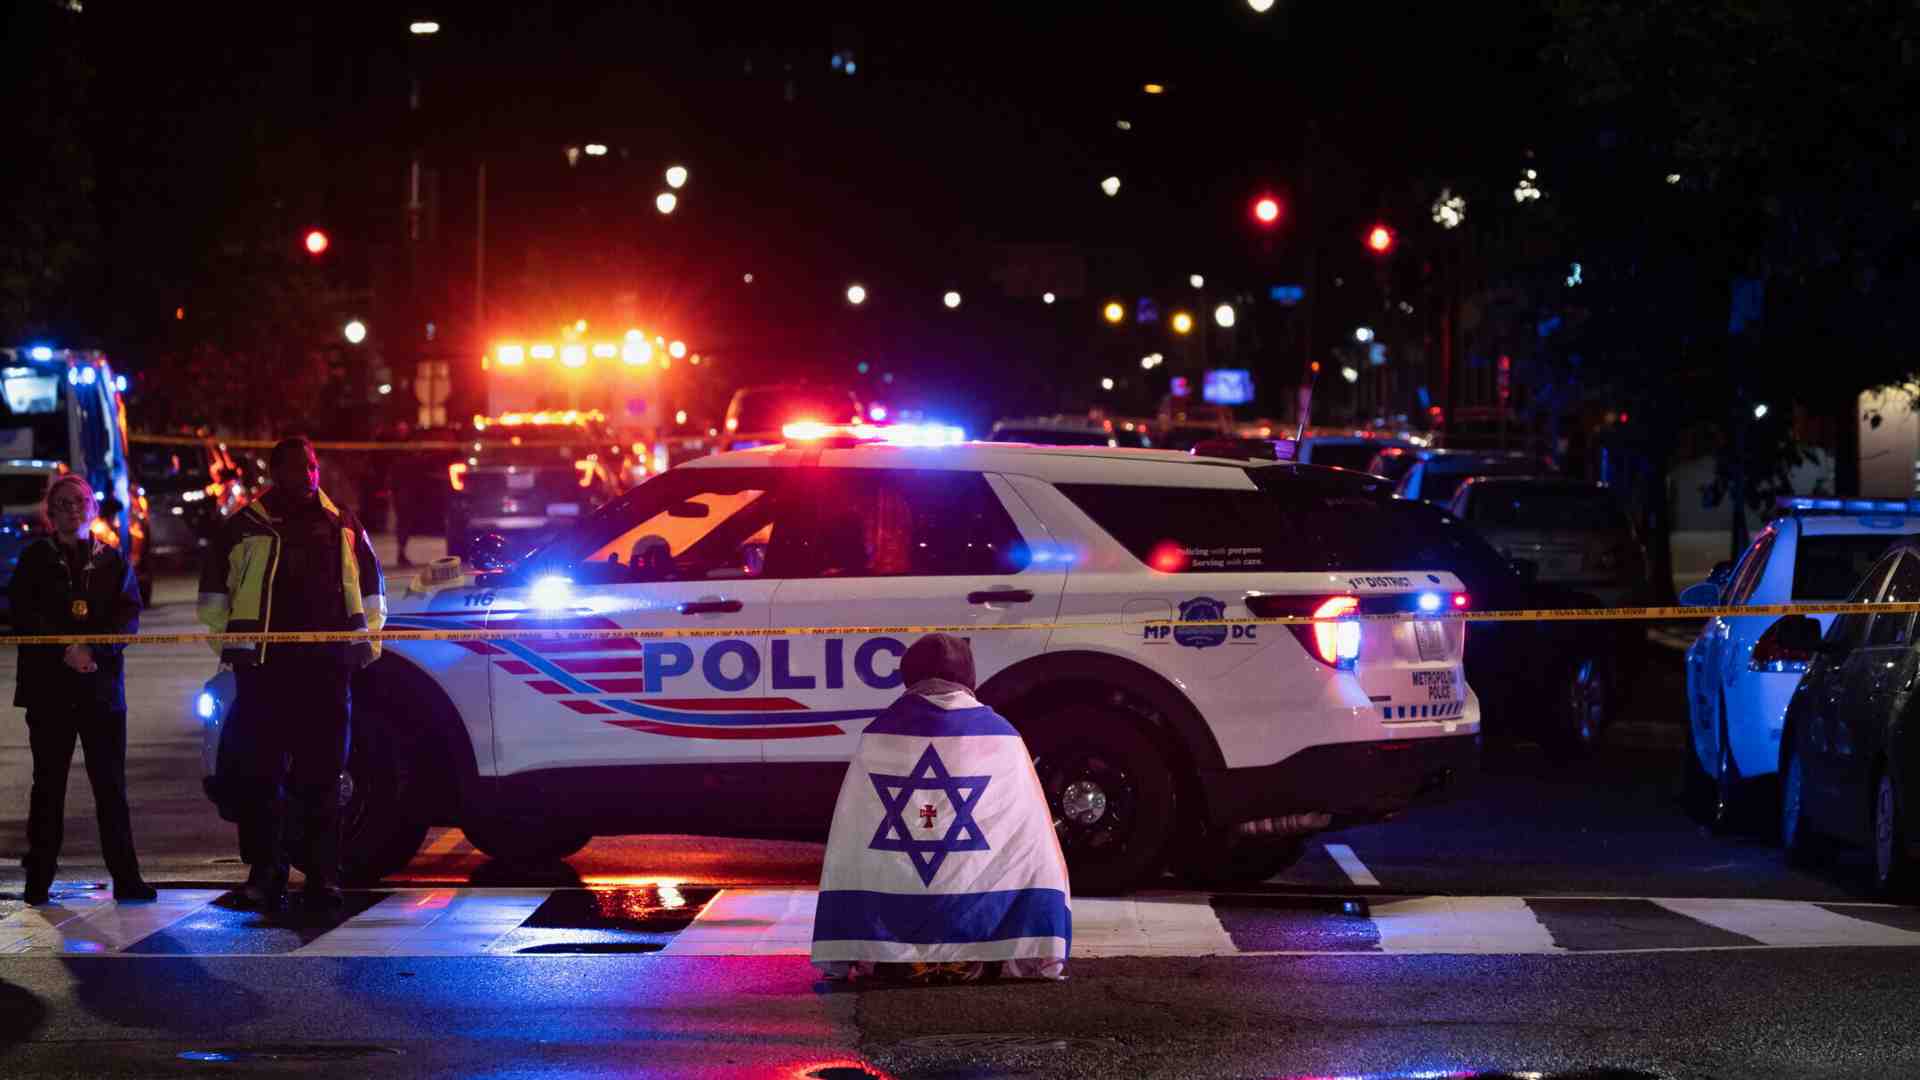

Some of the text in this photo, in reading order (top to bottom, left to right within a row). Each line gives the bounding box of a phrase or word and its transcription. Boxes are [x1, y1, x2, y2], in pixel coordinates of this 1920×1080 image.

[464, 592, 496, 606] 116
[1144, 625, 1171, 639] MP
[1231, 624, 1257, 638] DC
[643, 637, 970, 692] POLIC
[1412, 671, 1456, 687] METROPOL
[1429, 686, 1451, 700] POLICE
